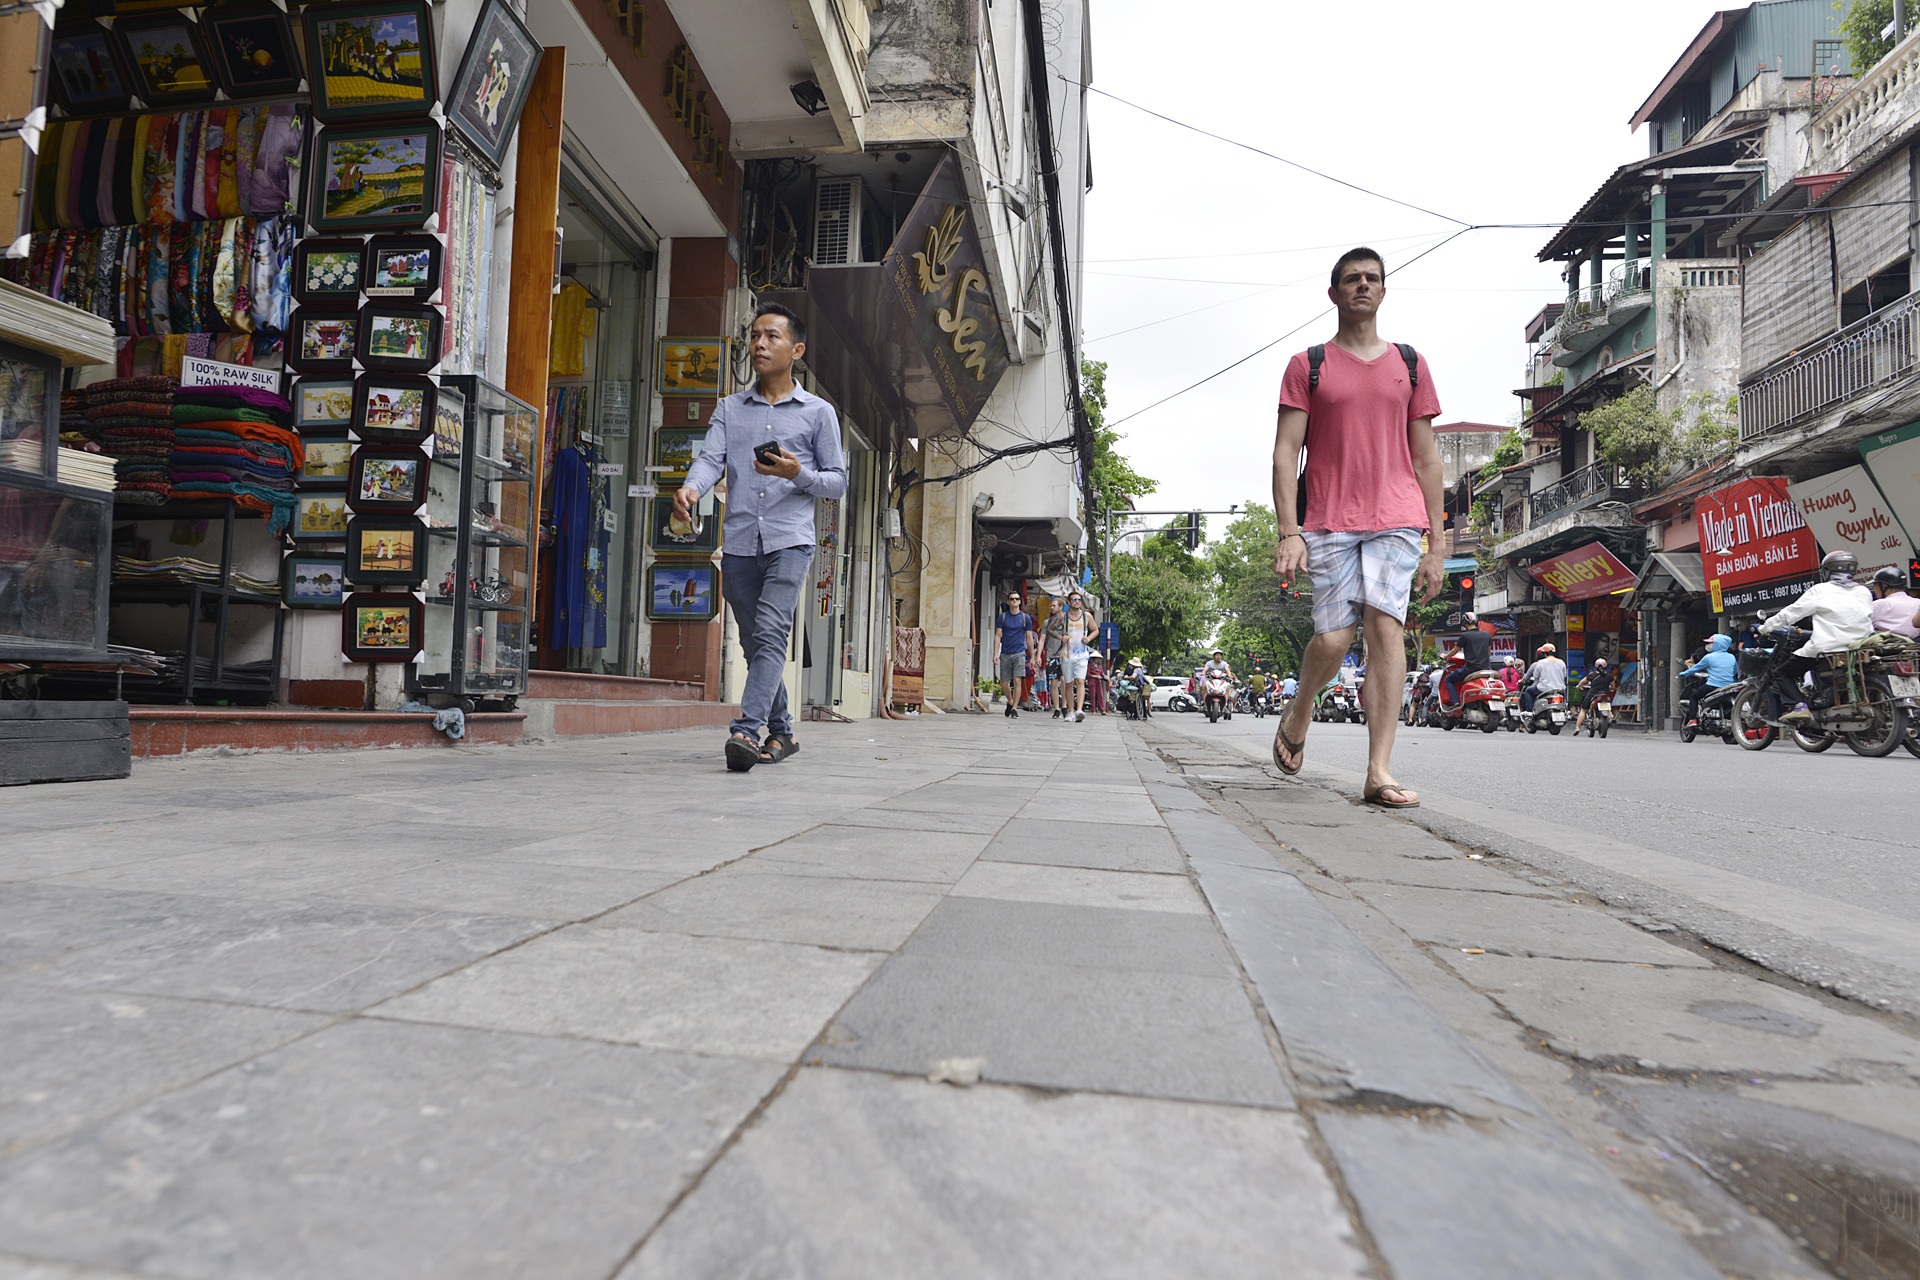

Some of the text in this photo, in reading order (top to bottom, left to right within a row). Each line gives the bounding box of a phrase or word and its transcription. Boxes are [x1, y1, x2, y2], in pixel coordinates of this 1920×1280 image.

[935, 268, 986, 382] Sen
[190, 361, 273, 385] 100% RAW SILK
[1802, 488, 1857, 514] Huong
[1701, 493, 1807, 554] Made in Vietnam
[1836, 507, 1890, 544] Quynh
[1716, 558, 1734, 576] BÁN
[1734, 552, 1759, 572] BUÔN
[1764, 545, 1785, 565] BÁN
[1786, 537, 1799, 560] LẺ
[1880, 535, 1902, 550] silk
[1542, 554, 1614, 593] gallery
[1757, 590, 1771, 601] TEL
